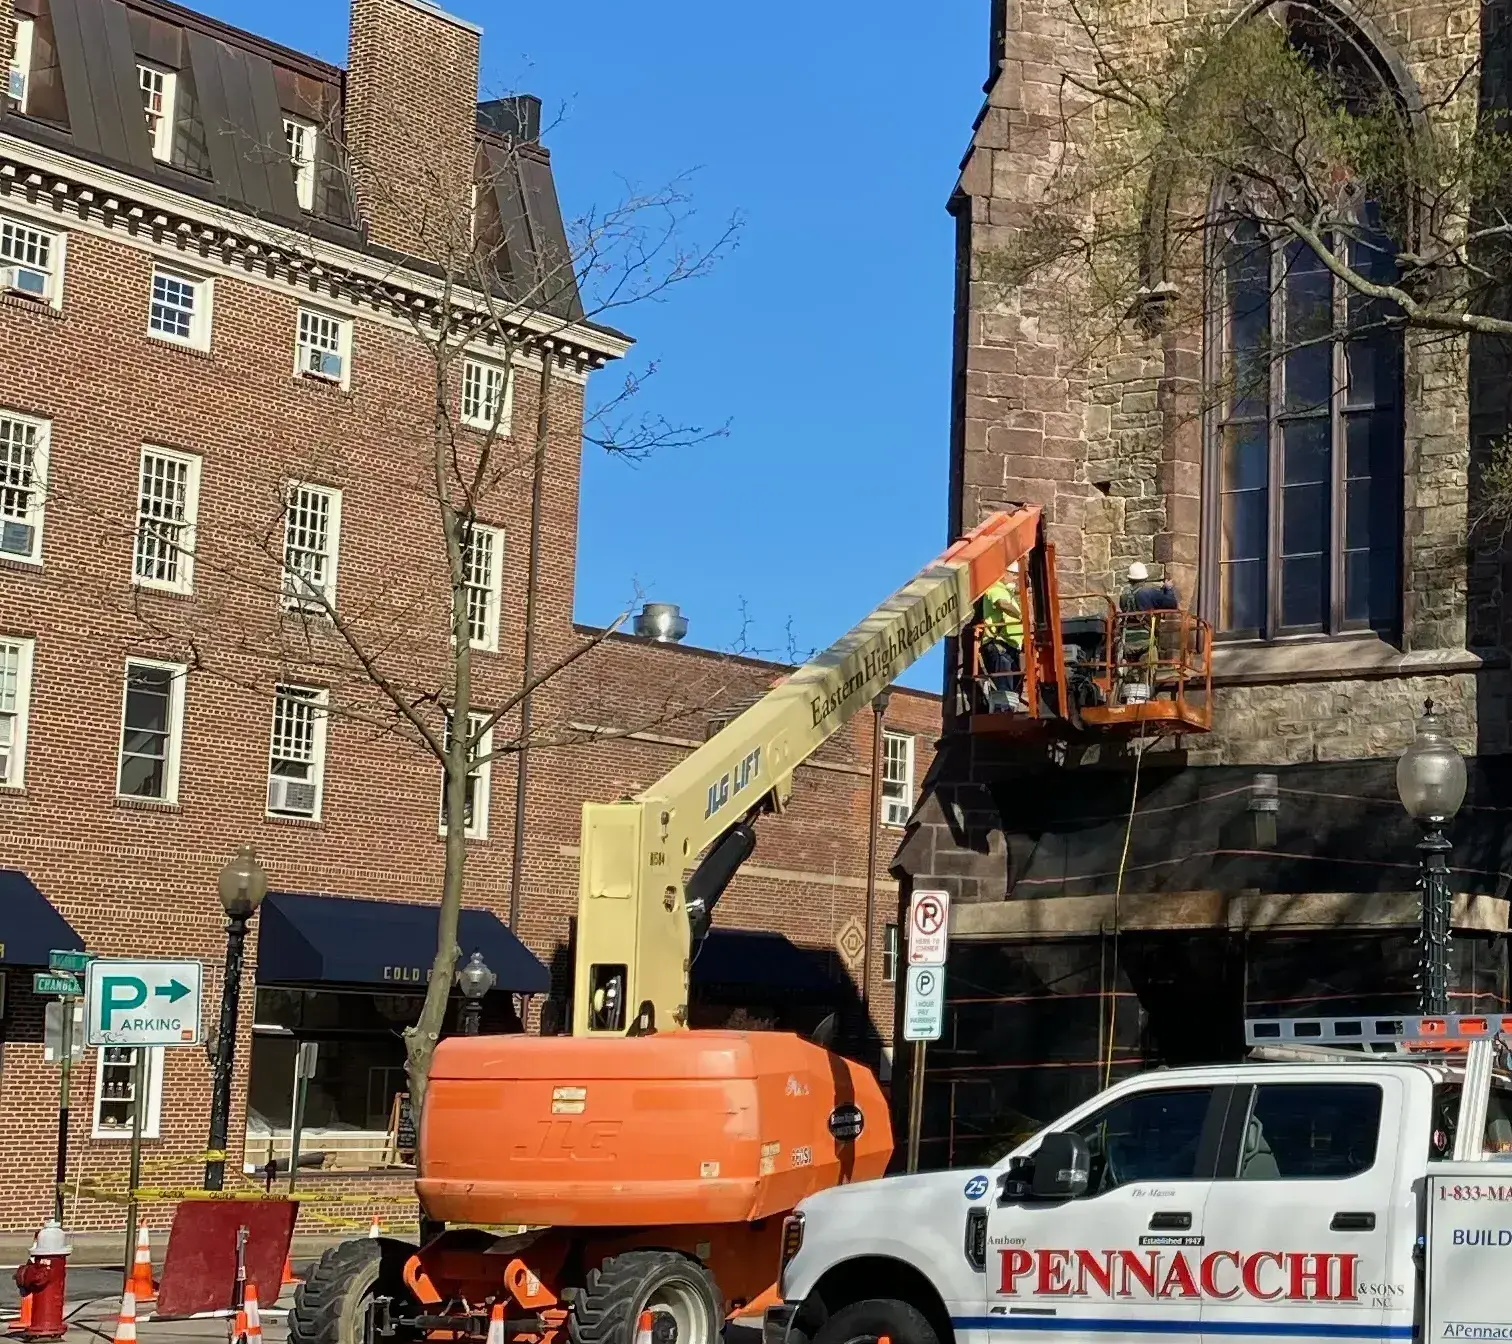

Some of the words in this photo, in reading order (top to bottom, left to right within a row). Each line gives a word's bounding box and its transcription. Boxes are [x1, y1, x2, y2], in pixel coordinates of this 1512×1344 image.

[810, 592, 959, 728] EasternHighReach.com
[705, 773, 730, 821] JLG
[733, 746, 761, 797] LIFT
[383, 966, 420, 982] COLD
[966, 1180, 985, 1195] 25
[988, 1235, 1027, 1247] Anthony
[1142, 1236, 1182, 1245] Established
[1185, 1237, 1202, 1245] 1947
[996, 1249, 1361, 1302] PENNACCHI
[1358, 1282, 1368, 1295] &
[1370, 1284, 1405, 1296] SONS
